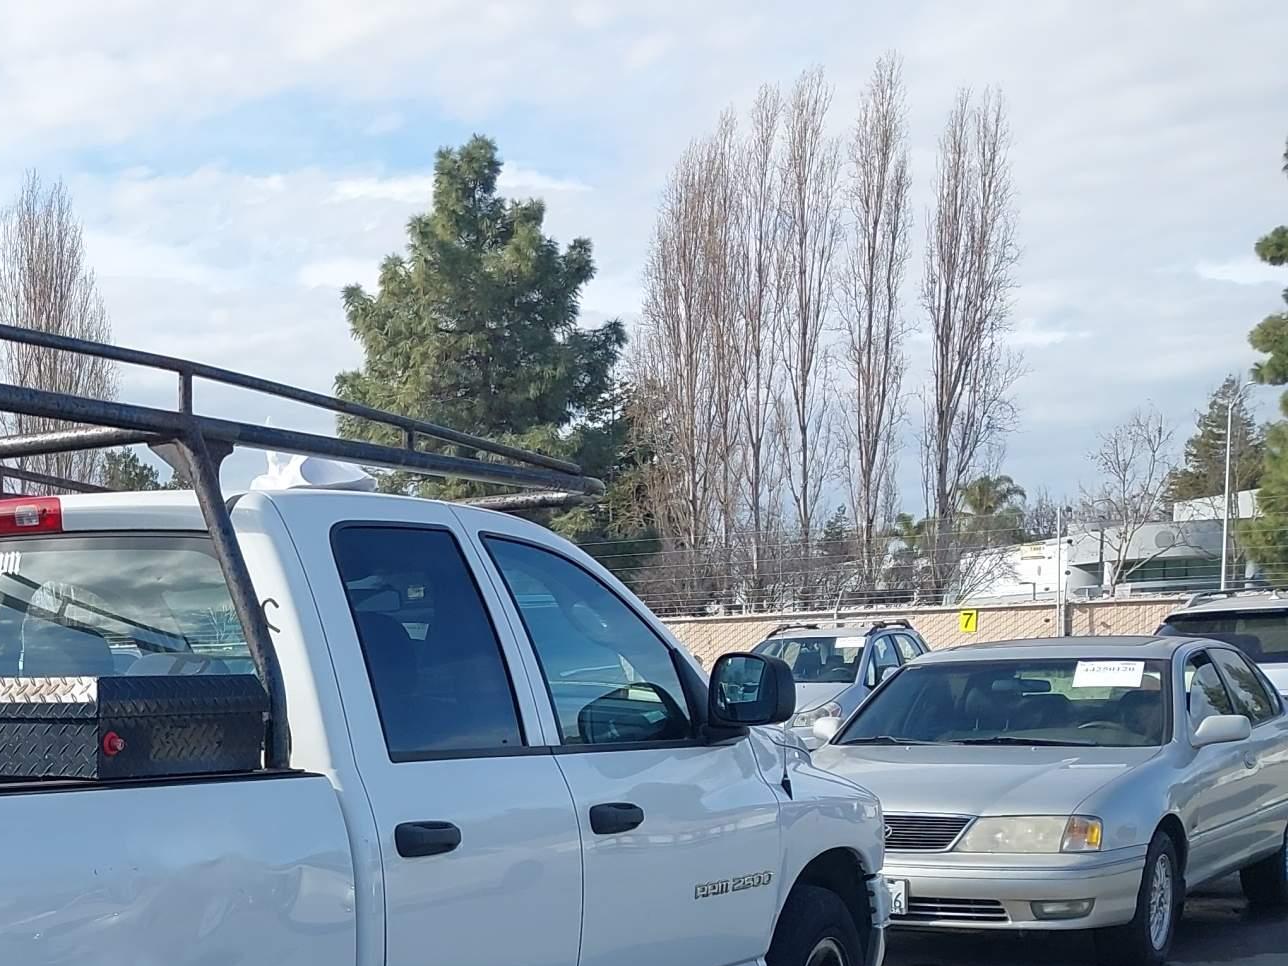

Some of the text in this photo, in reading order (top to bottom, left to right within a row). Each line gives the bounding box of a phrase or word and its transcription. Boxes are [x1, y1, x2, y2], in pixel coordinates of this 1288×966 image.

[962, 612, 974, 629] 7
[695, 870, 775, 899] RAM 2500
